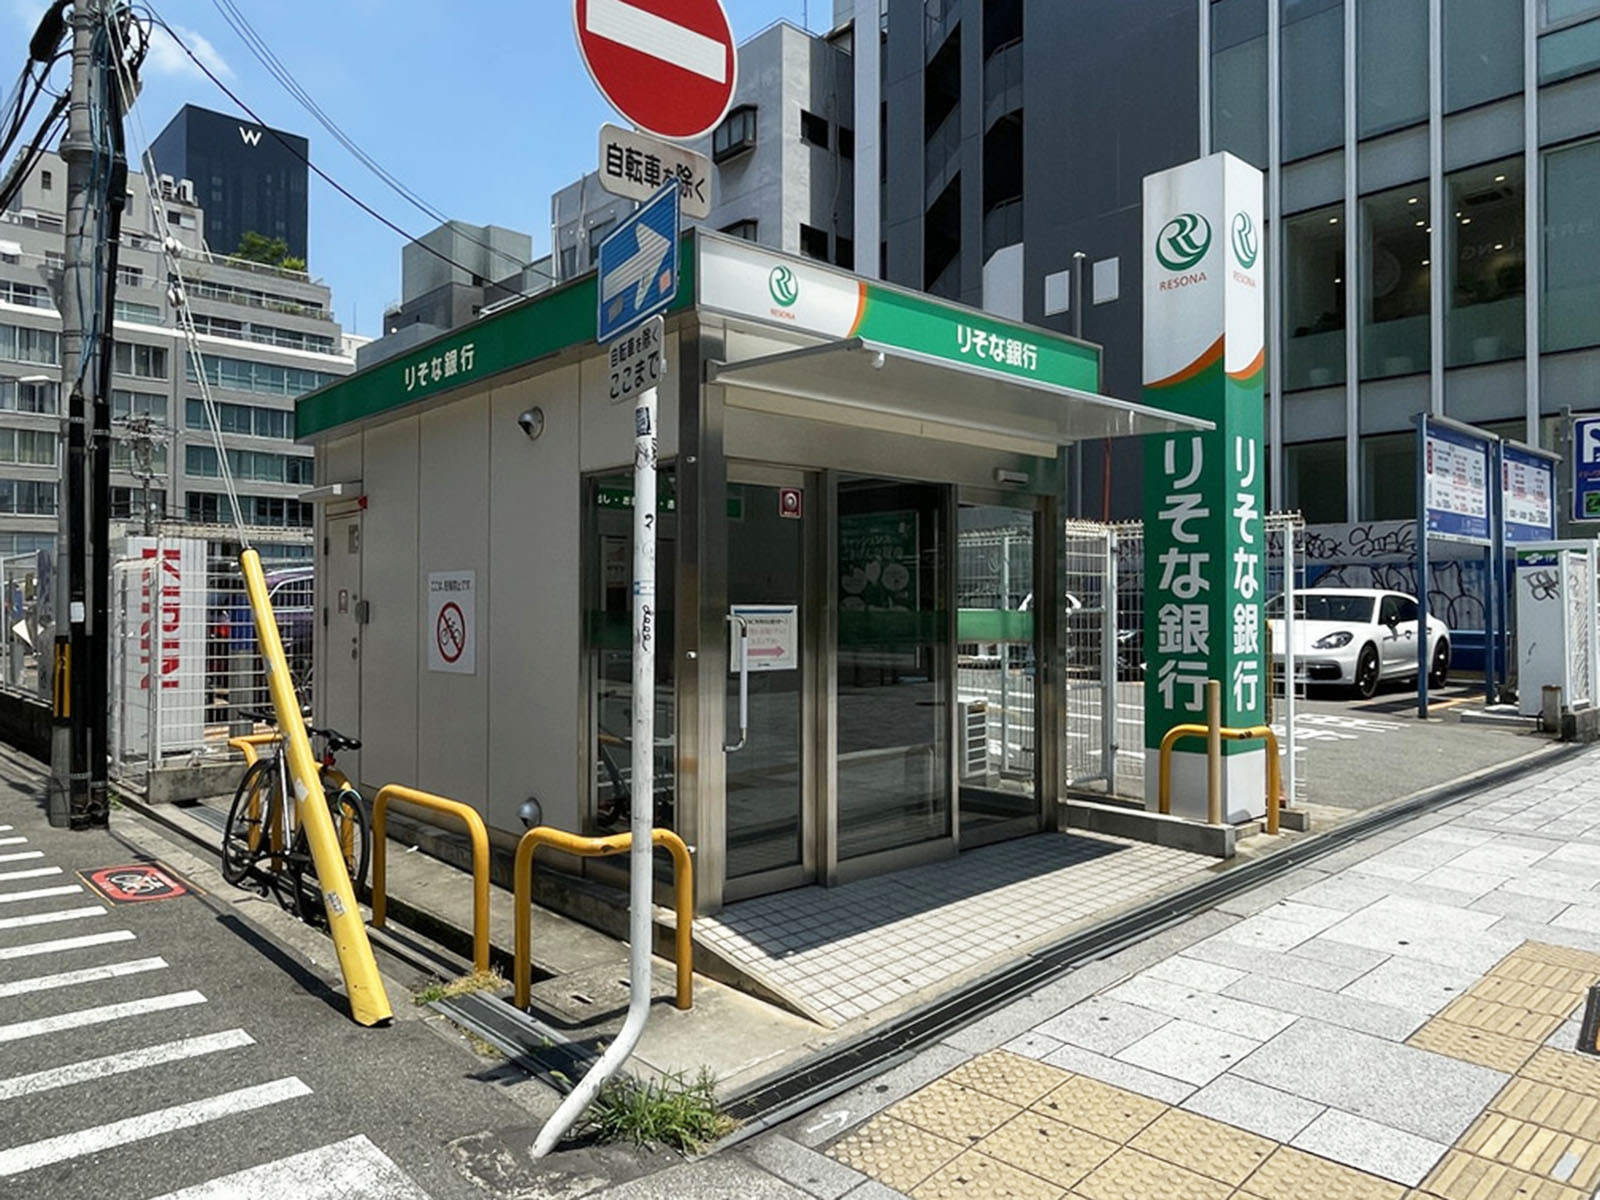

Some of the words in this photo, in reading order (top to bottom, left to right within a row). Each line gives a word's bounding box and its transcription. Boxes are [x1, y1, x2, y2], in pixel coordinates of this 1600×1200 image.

[239, 126, 262, 147] W
[1160, 271, 1208, 292] RESONA
[404, 343, 475, 392] りそな銀行
[957, 324, 1038, 371] りそな銀行
[609, 350, 660, 399] ここまで
[1157, 436, 1211, 713] りそな銀行
[1233, 435, 1259, 712] りそな銀行
